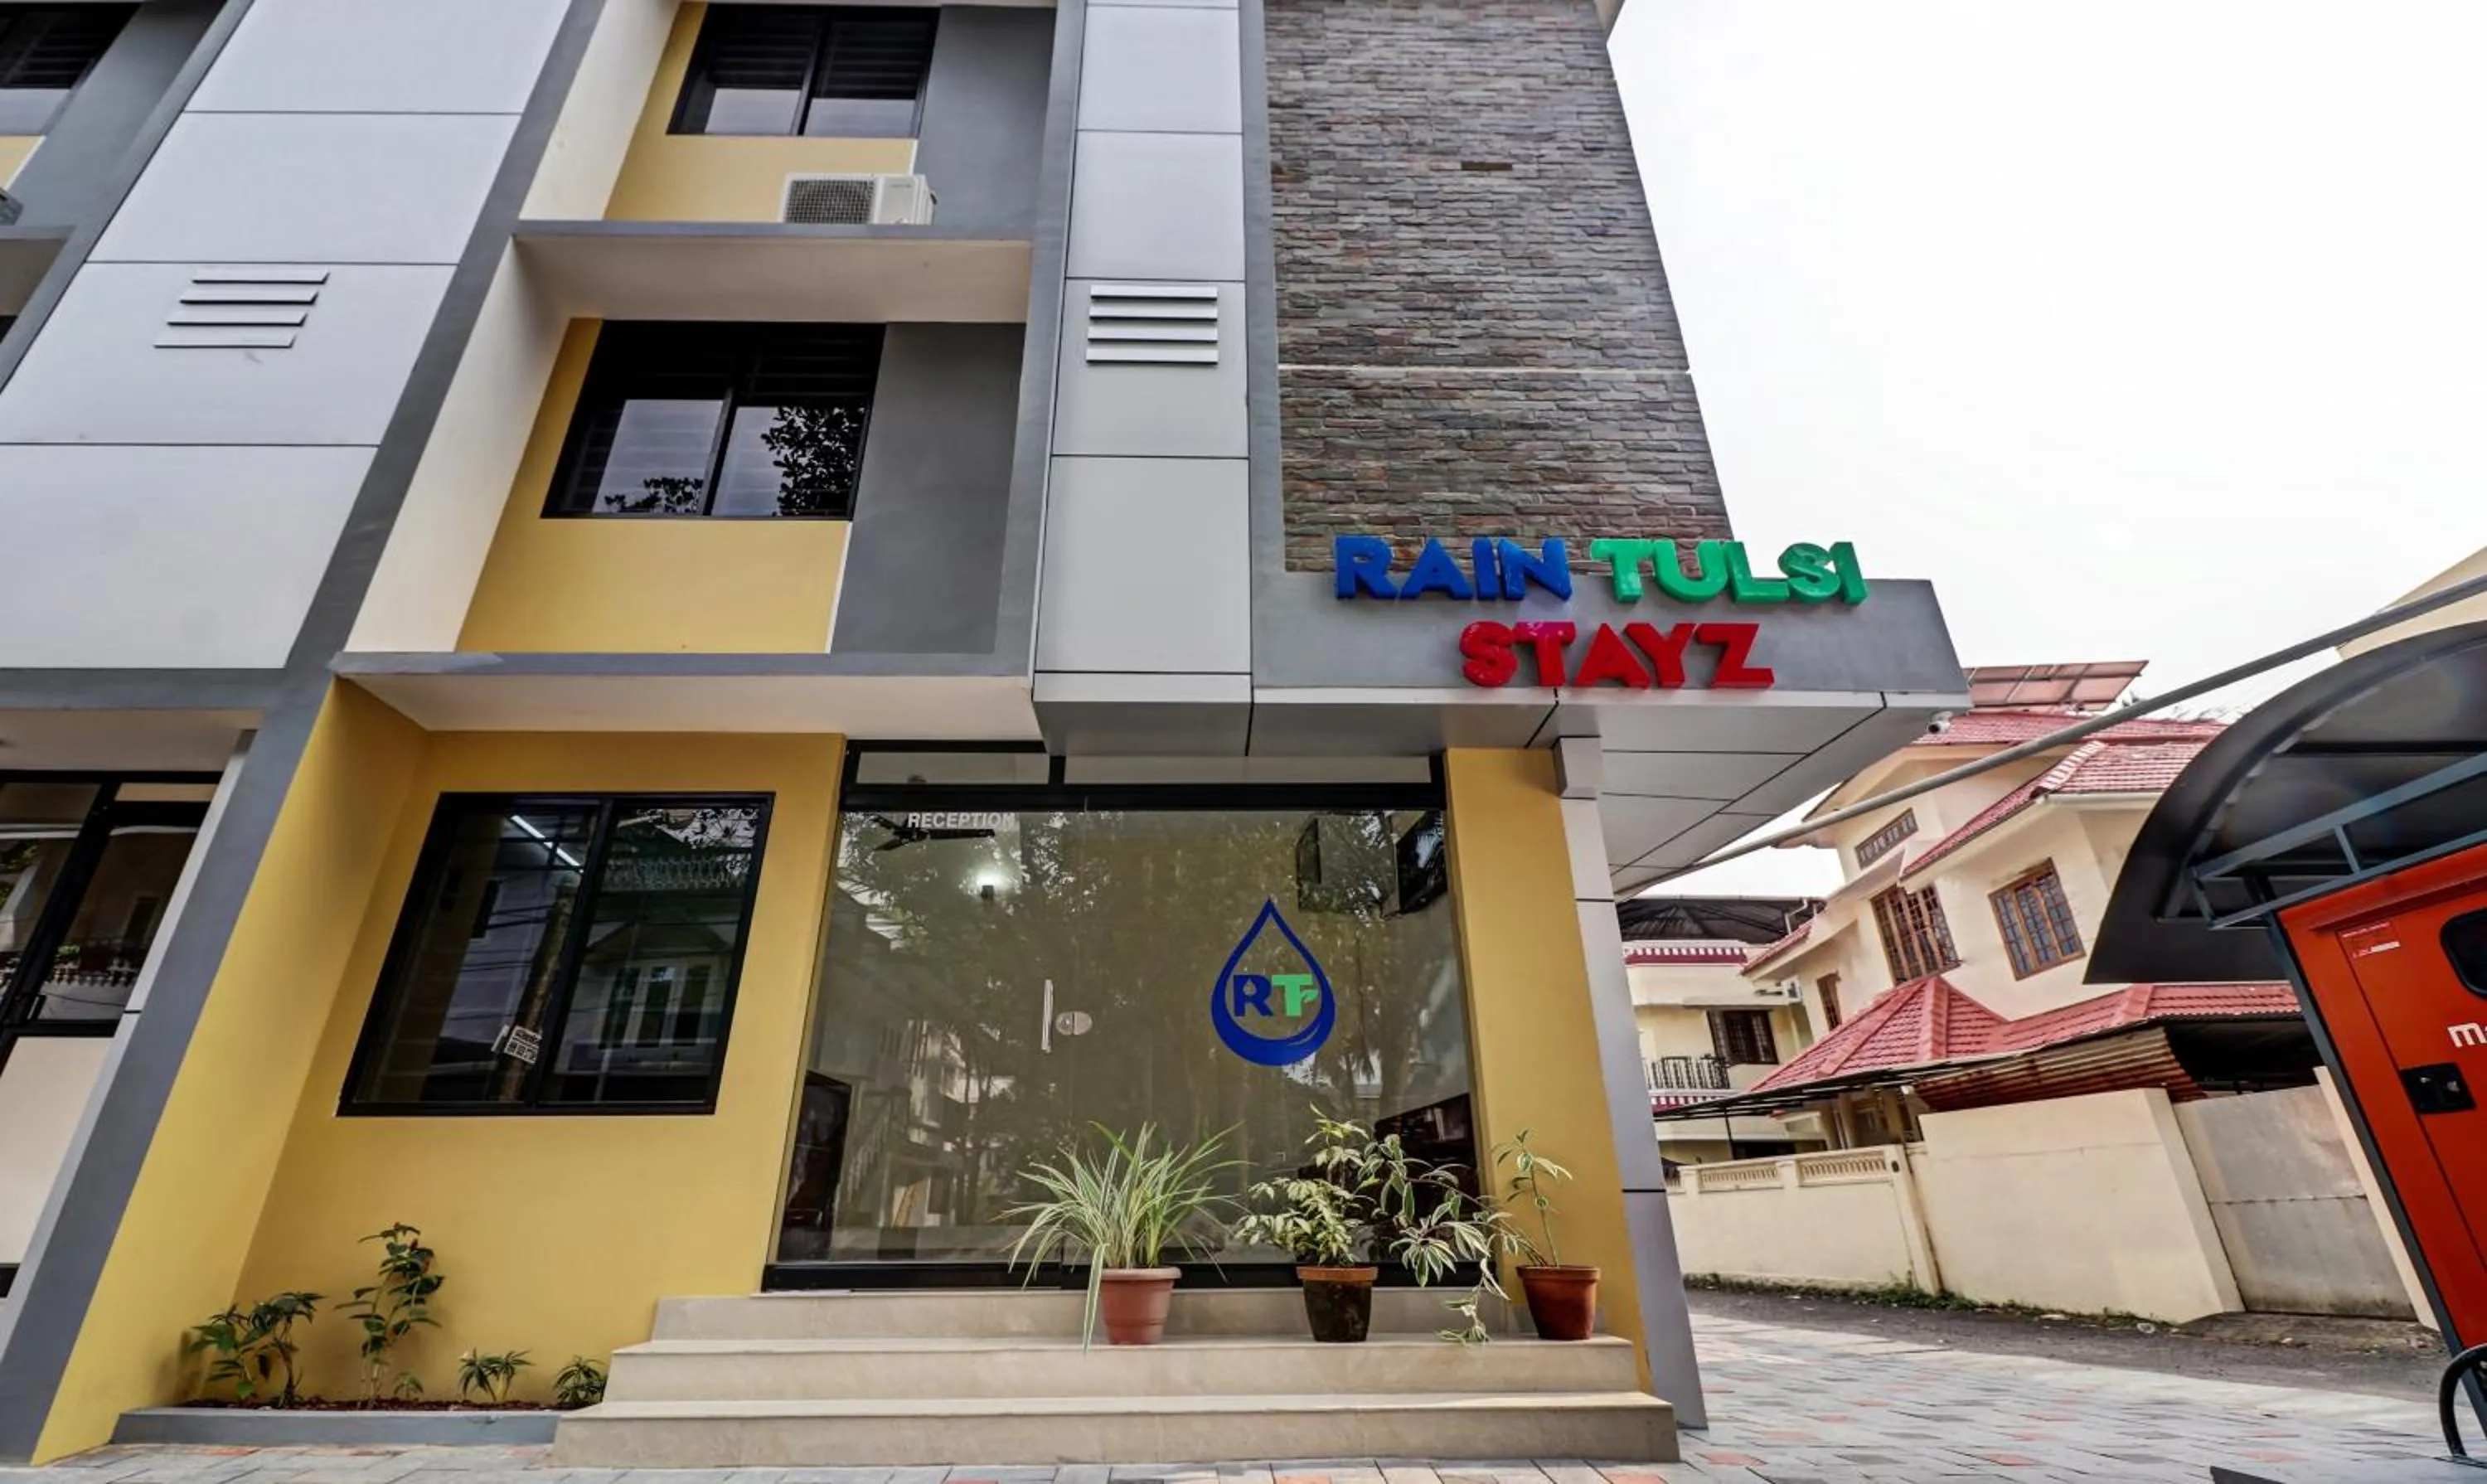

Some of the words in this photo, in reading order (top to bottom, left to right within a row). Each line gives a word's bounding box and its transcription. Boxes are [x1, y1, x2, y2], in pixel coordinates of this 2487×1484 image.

[1334, 535, 1573, 601] RAIN
[1589, 537, 1869, 606] TULSI
[1458, 620, 1775, 690] STAYZ
[907, 811, 1016, 829] RECEPTION
[1233, 974, 1318, 1017] RT
